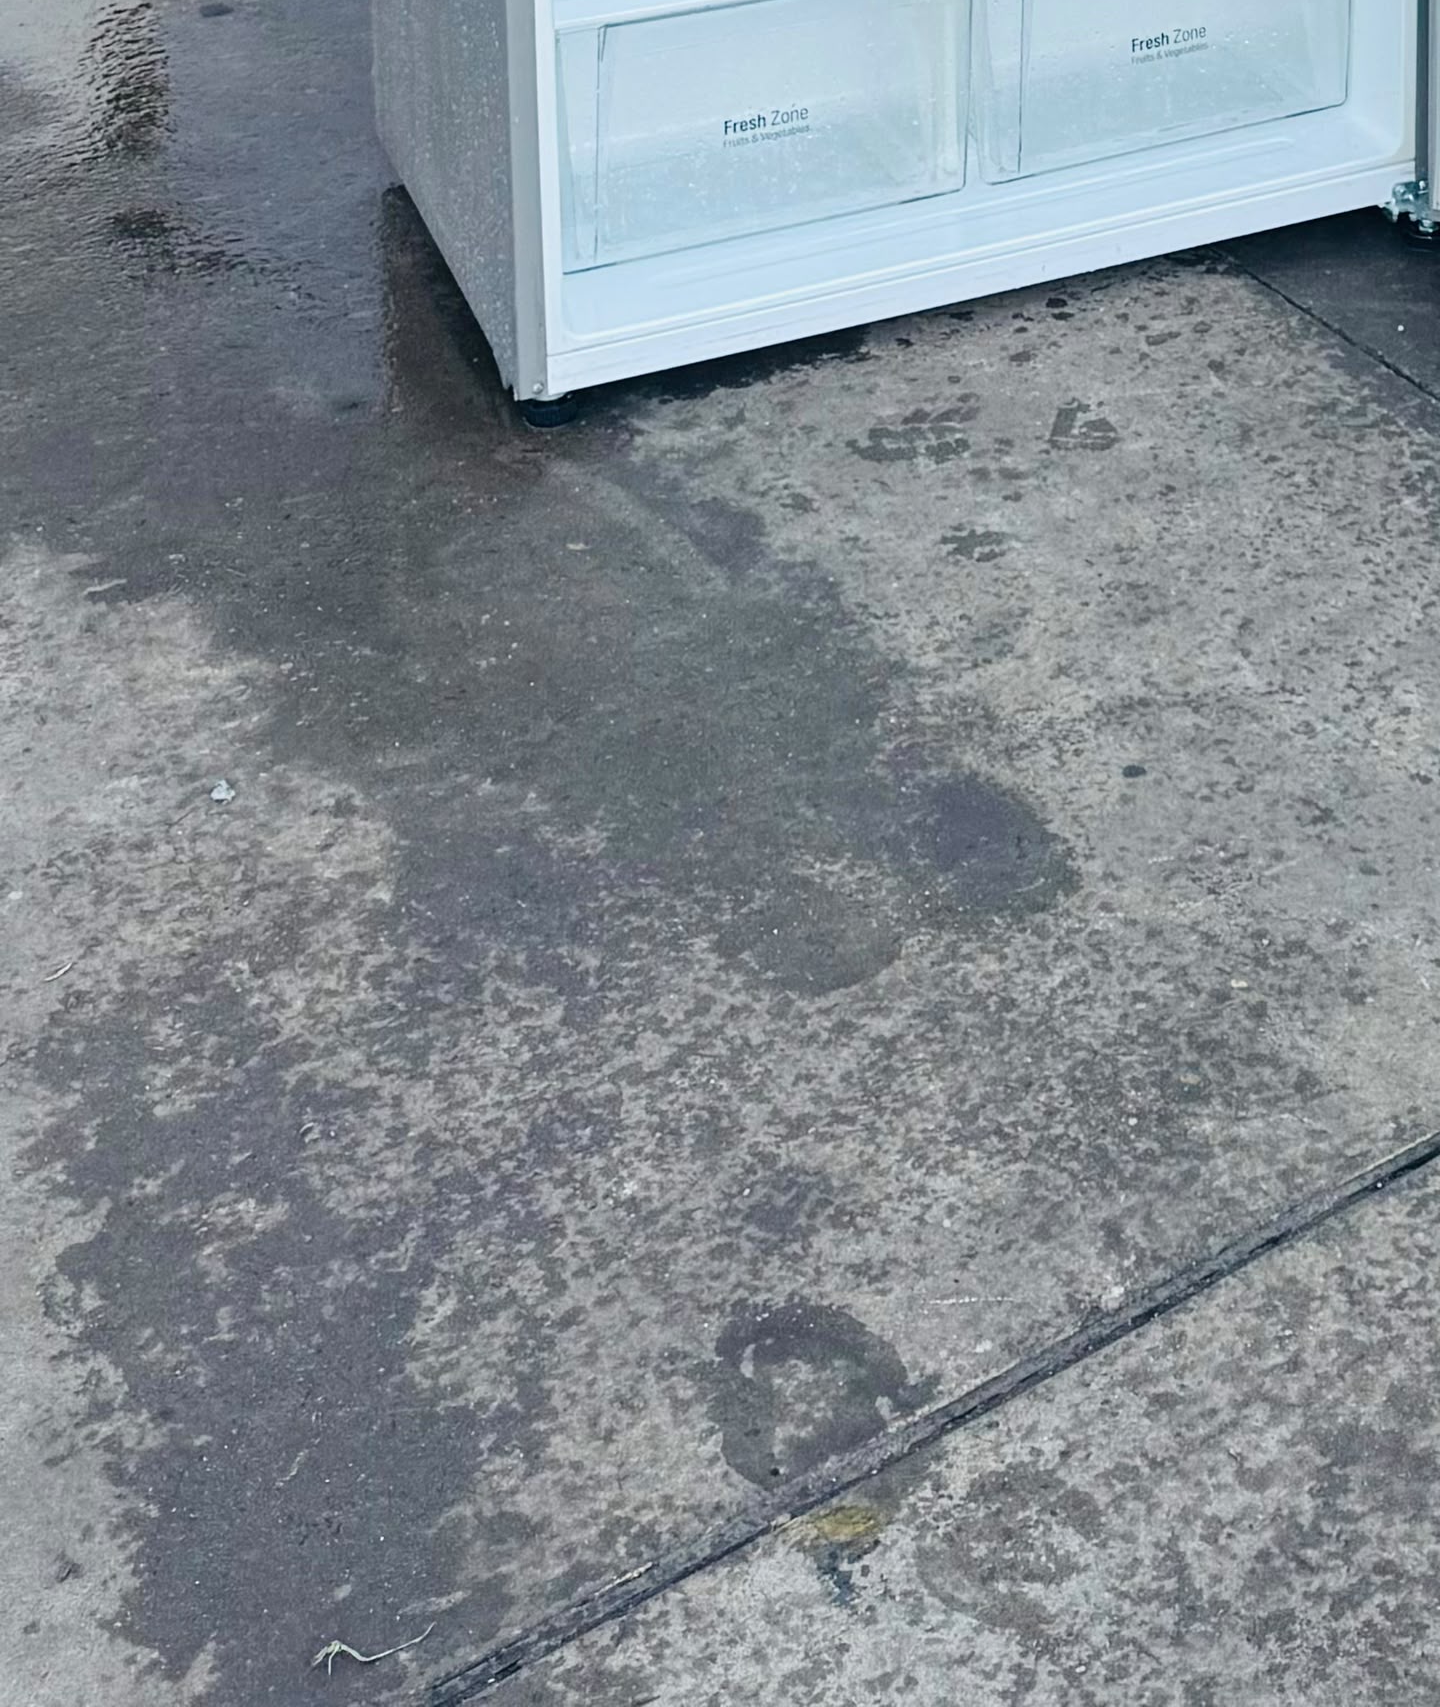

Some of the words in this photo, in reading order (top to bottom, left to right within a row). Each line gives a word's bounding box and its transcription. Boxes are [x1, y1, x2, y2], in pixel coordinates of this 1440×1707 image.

[1131, 32, 1170, 54] Fresh
[1173, 26, 1206, 44] Zone
[724, 114, 767, 136] Fresh
[771, 107, 809, 127] Zone
